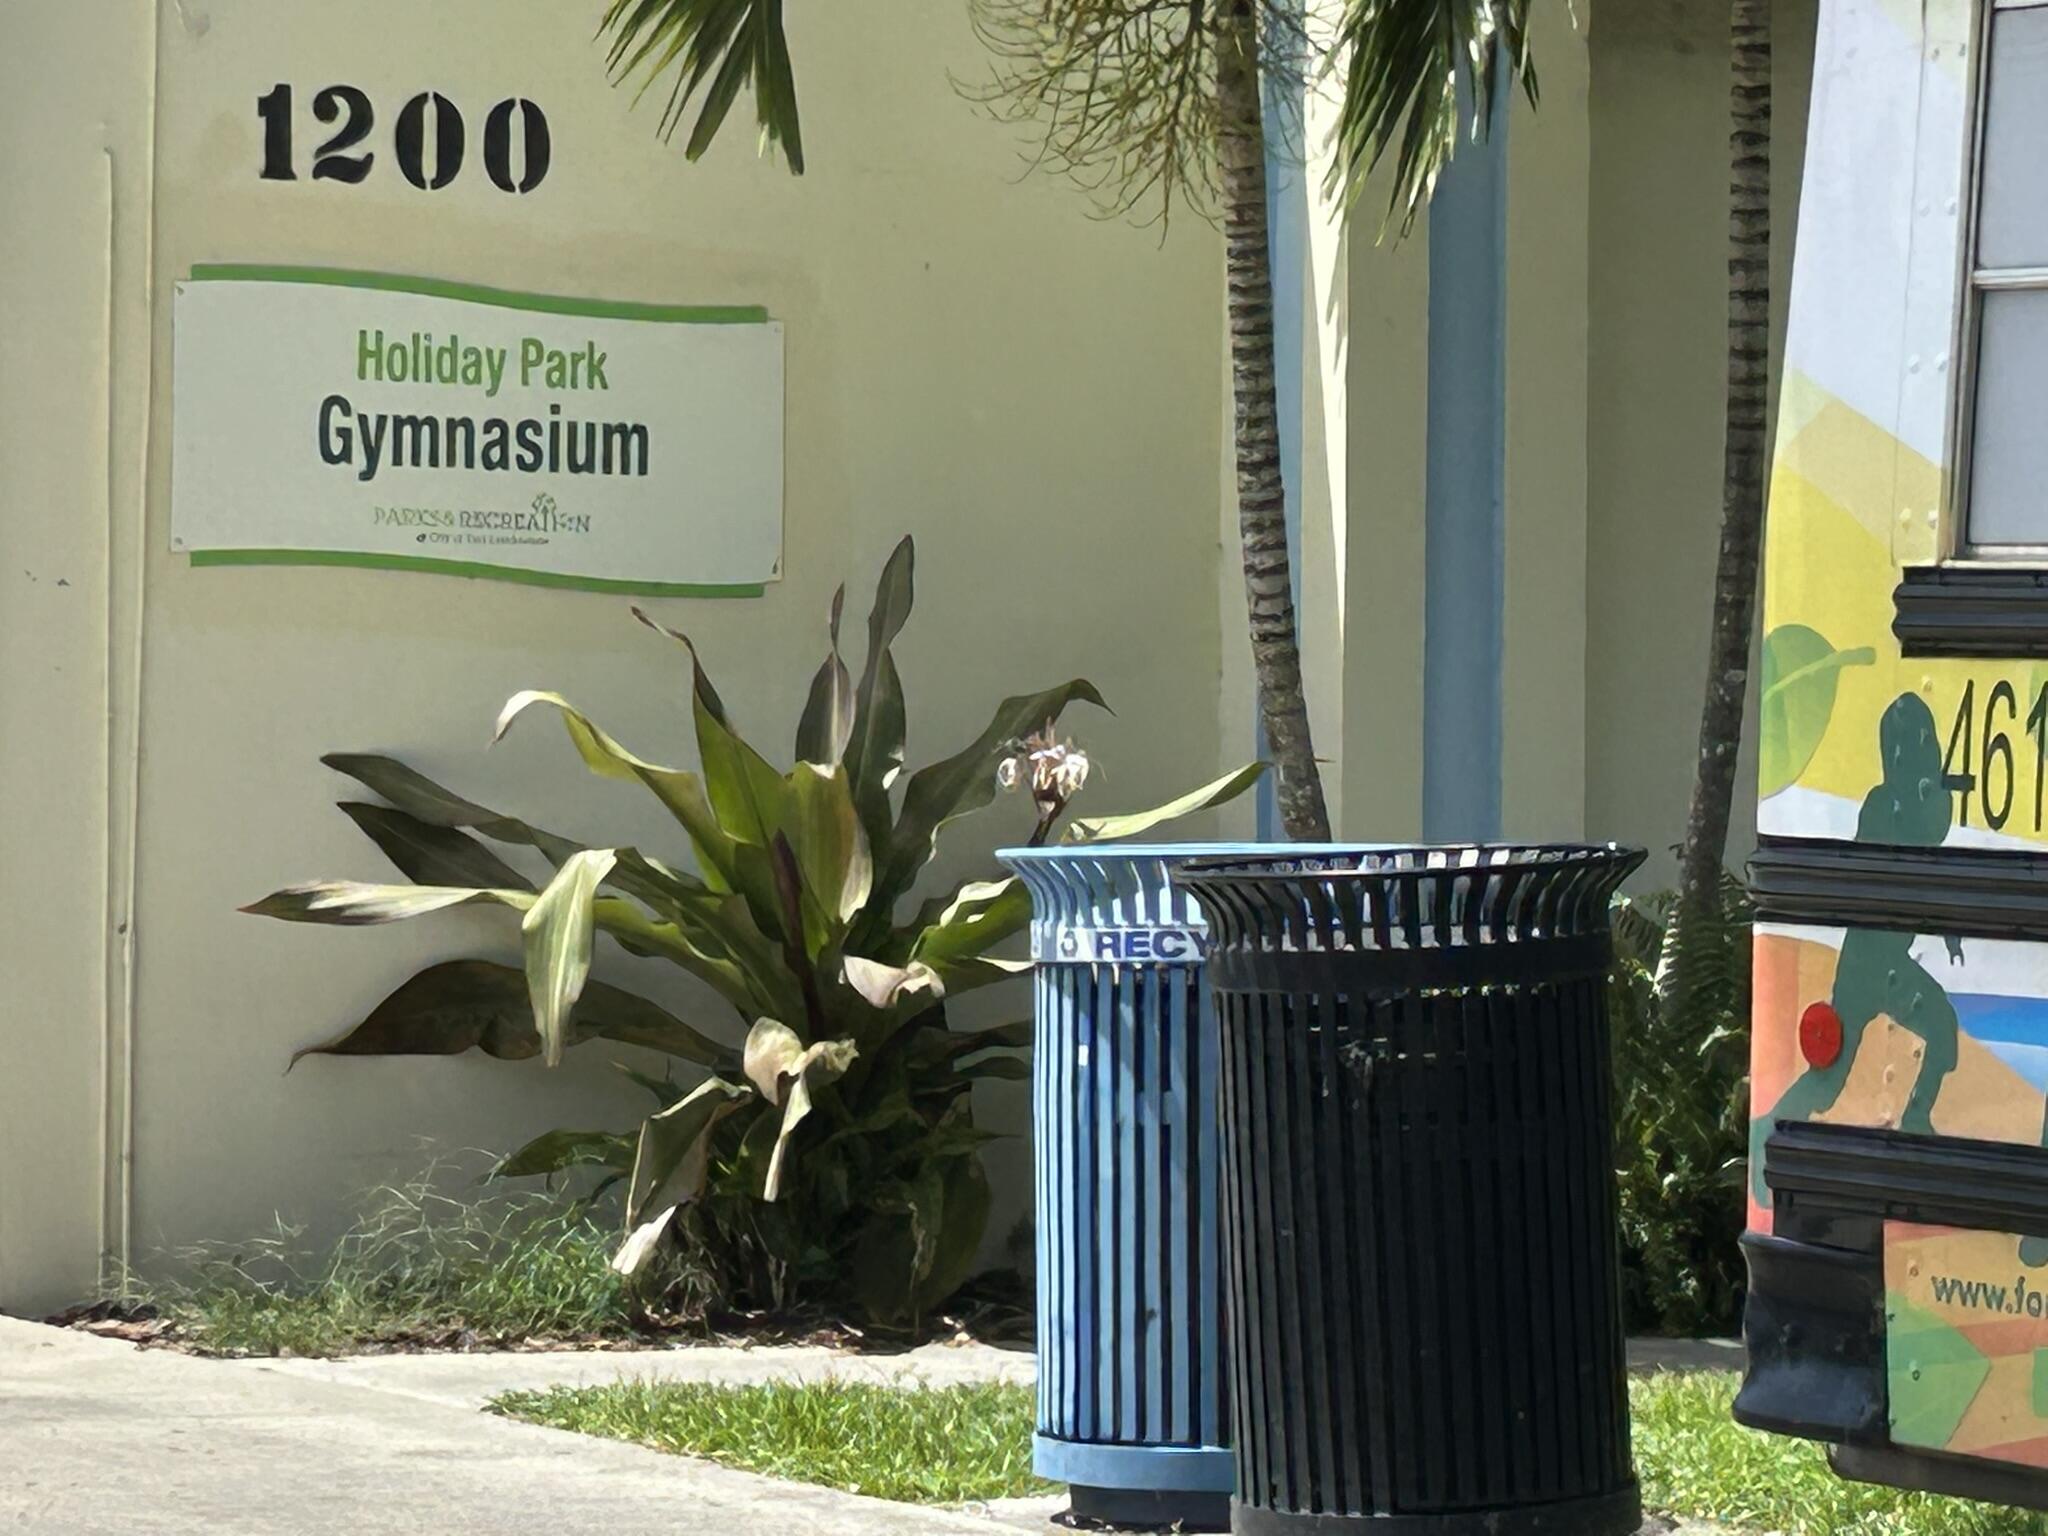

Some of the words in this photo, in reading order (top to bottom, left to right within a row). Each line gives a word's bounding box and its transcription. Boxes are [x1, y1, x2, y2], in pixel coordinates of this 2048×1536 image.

[257, 84, 551, 194] 1200
[357, 330, 507, 396] Holiday
[521, 338, 609, 390] Park
[318, 395, 650, 481] Gymnasium
[1931, 1275, 2048, 1318] www.fo
